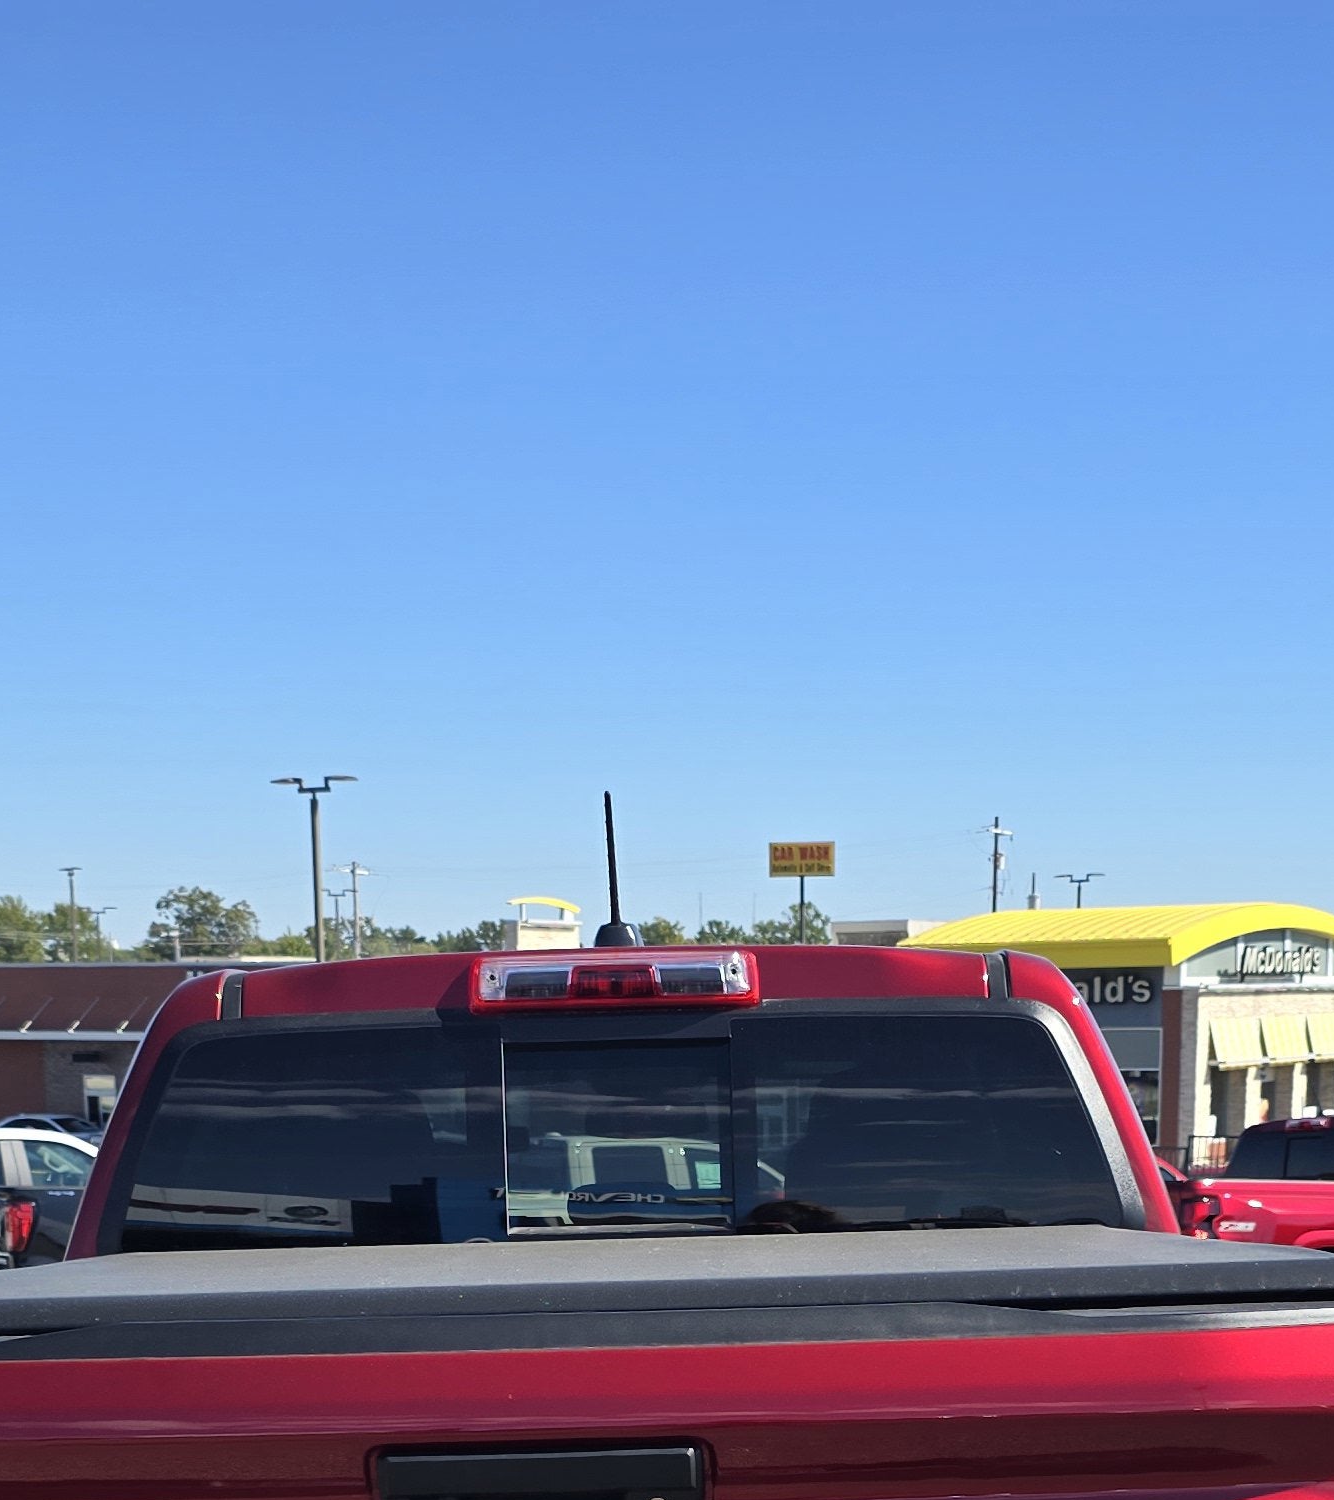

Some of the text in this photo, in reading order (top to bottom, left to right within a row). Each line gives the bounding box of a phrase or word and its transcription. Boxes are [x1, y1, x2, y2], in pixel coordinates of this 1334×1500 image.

[773, 845, 830, 861] CAR WASH
[1242, 945, 1321, 975] McDonald's
[1075, 974, 1151, 1003] ald's
